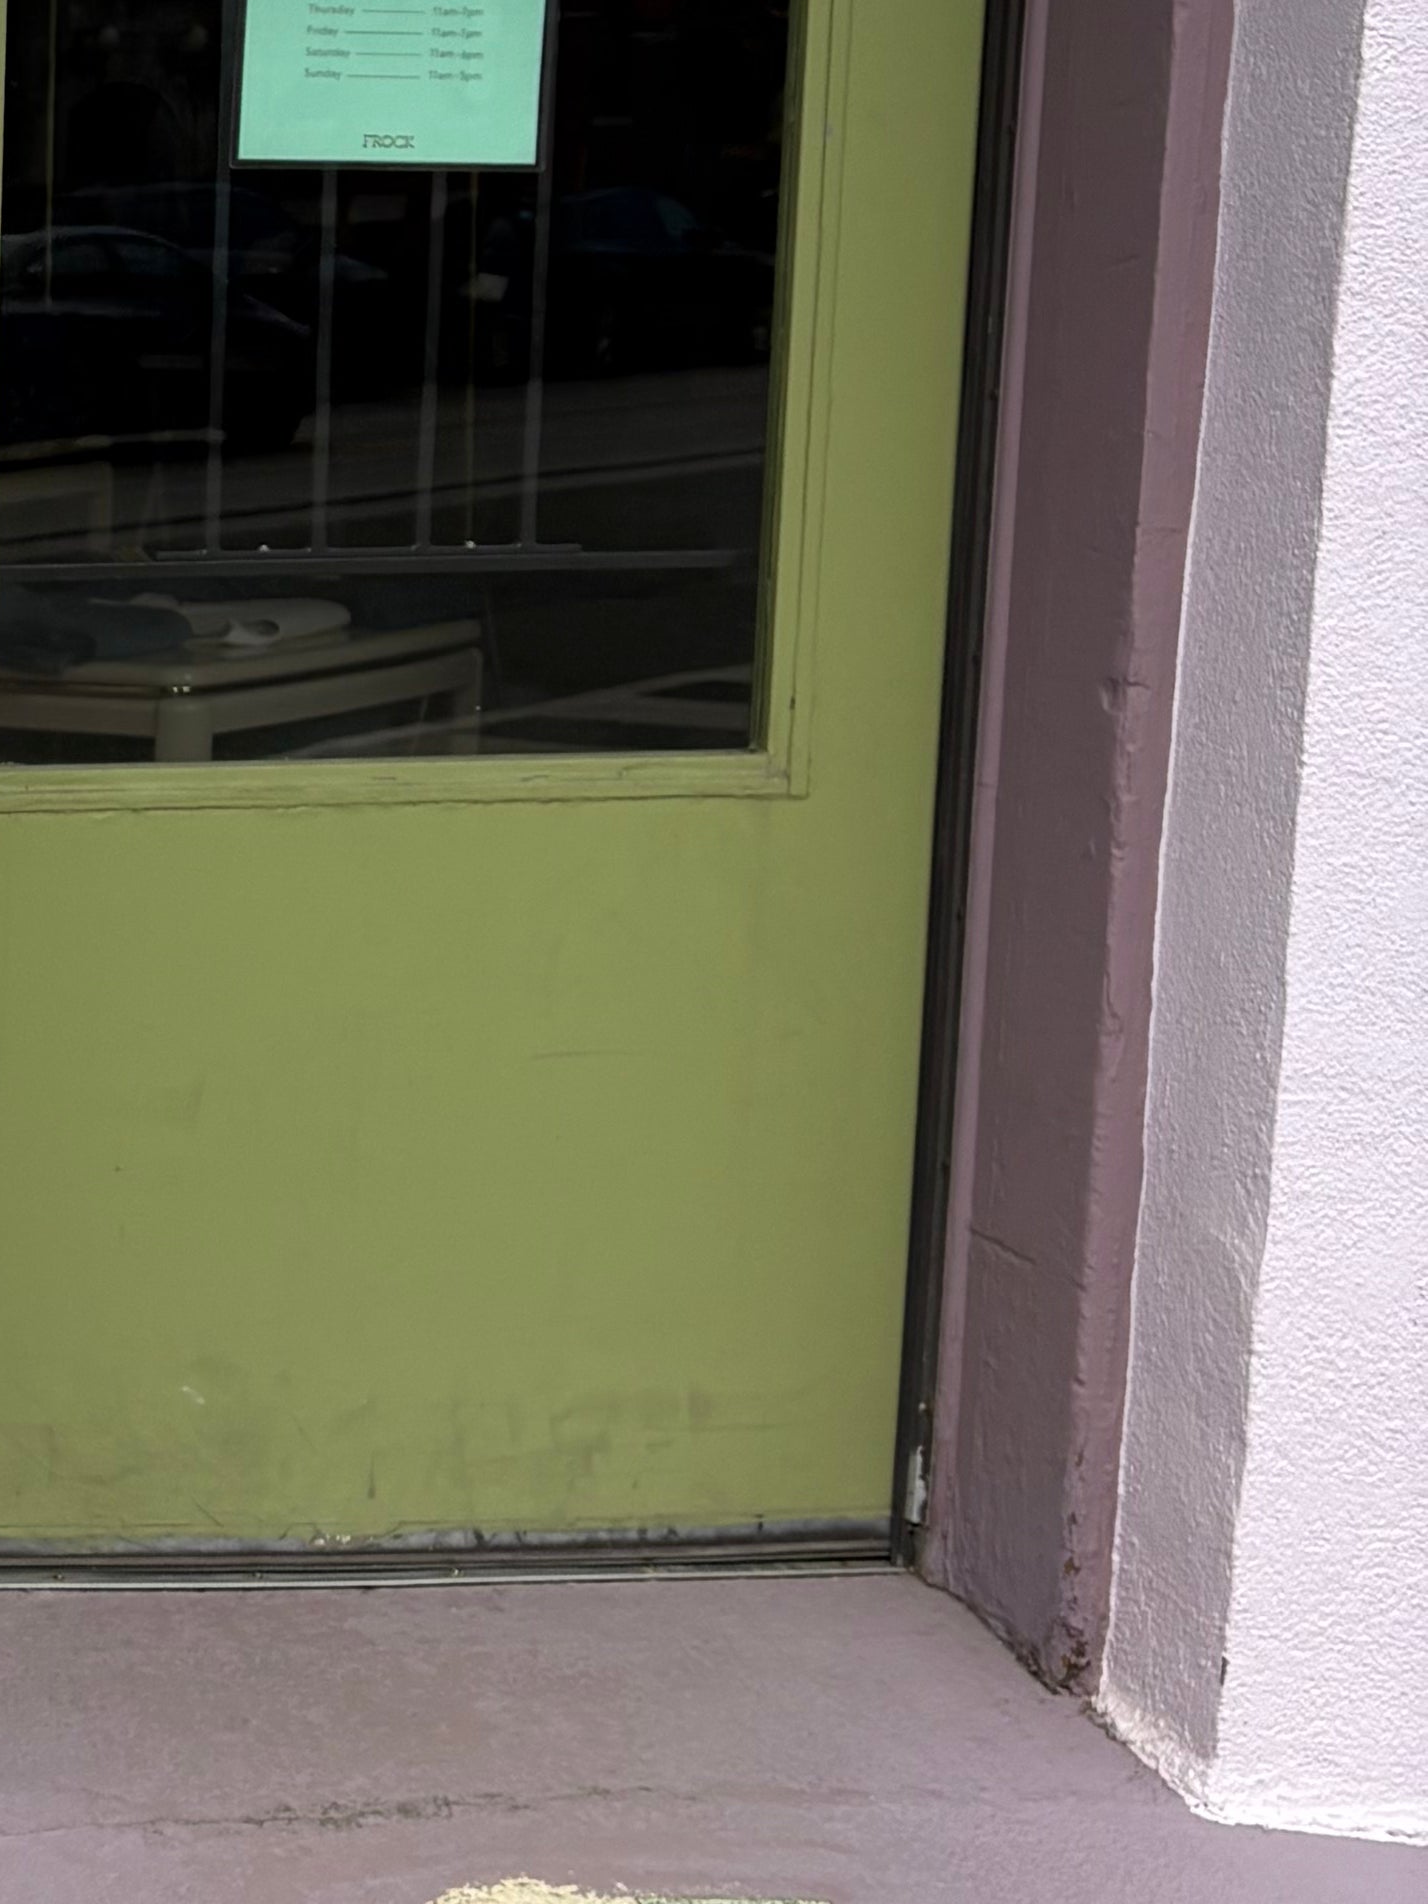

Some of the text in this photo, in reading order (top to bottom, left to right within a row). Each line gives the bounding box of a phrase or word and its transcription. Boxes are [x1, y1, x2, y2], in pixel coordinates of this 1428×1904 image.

[307, 3, 355, 17] Thursday
[306, 25, 339, 38] Friday
[305, 47, 351, 59] Saturday
[304, 67, 341, 81] Sunday
